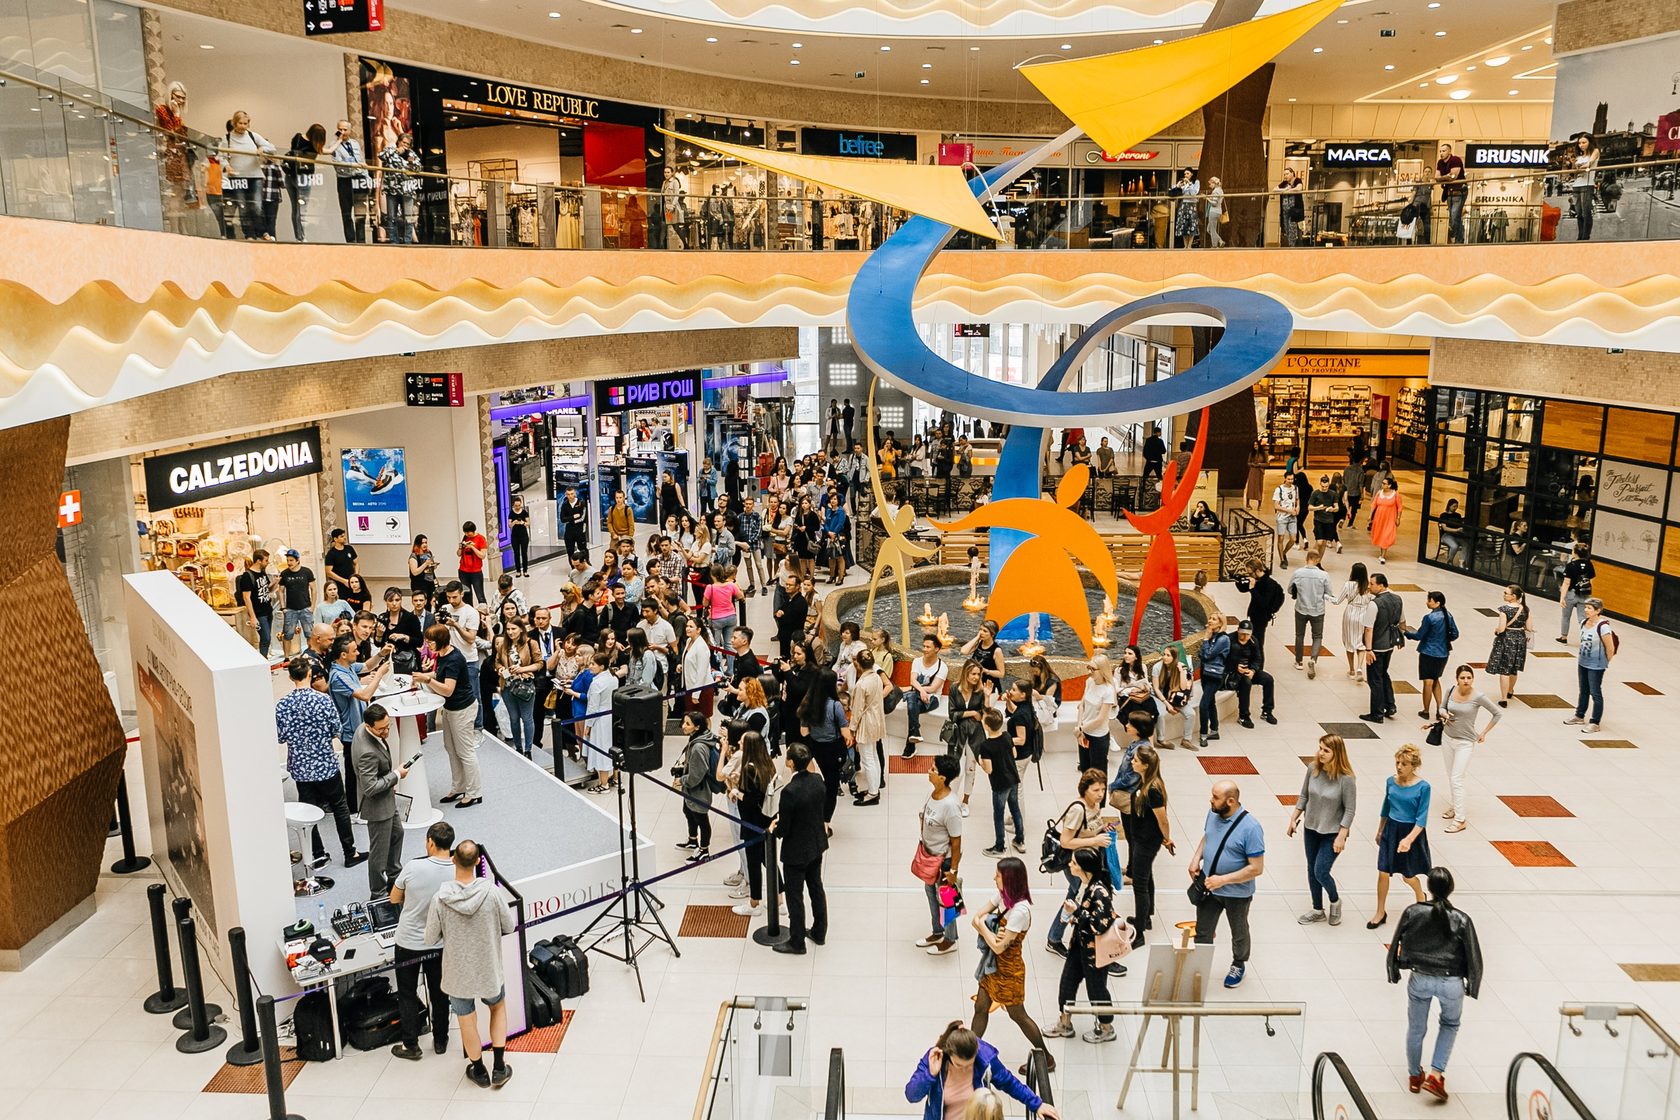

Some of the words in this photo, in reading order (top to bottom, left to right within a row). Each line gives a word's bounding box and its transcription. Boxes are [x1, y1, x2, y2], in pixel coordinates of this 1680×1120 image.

[486, 82, 528, 108] LOVE
[532, 91, 599, 118] REPUBLIC
[839, 133, 884, 155] befree
[1000, 146, 1025, 156] Паст
[1328, 148, 1392, 162] MARCA
[1476, 148, 1550, 164] BRUSNIK
[1474, 195, 1524, 204] BRUSNIKA
[627, 382, 660, 404] РИВ
[662, 378, 694, 400] ГОШ
[169, 441, 313, 495] CALZEDONIA
[526, 879, 616, 920] UROPOLIS
